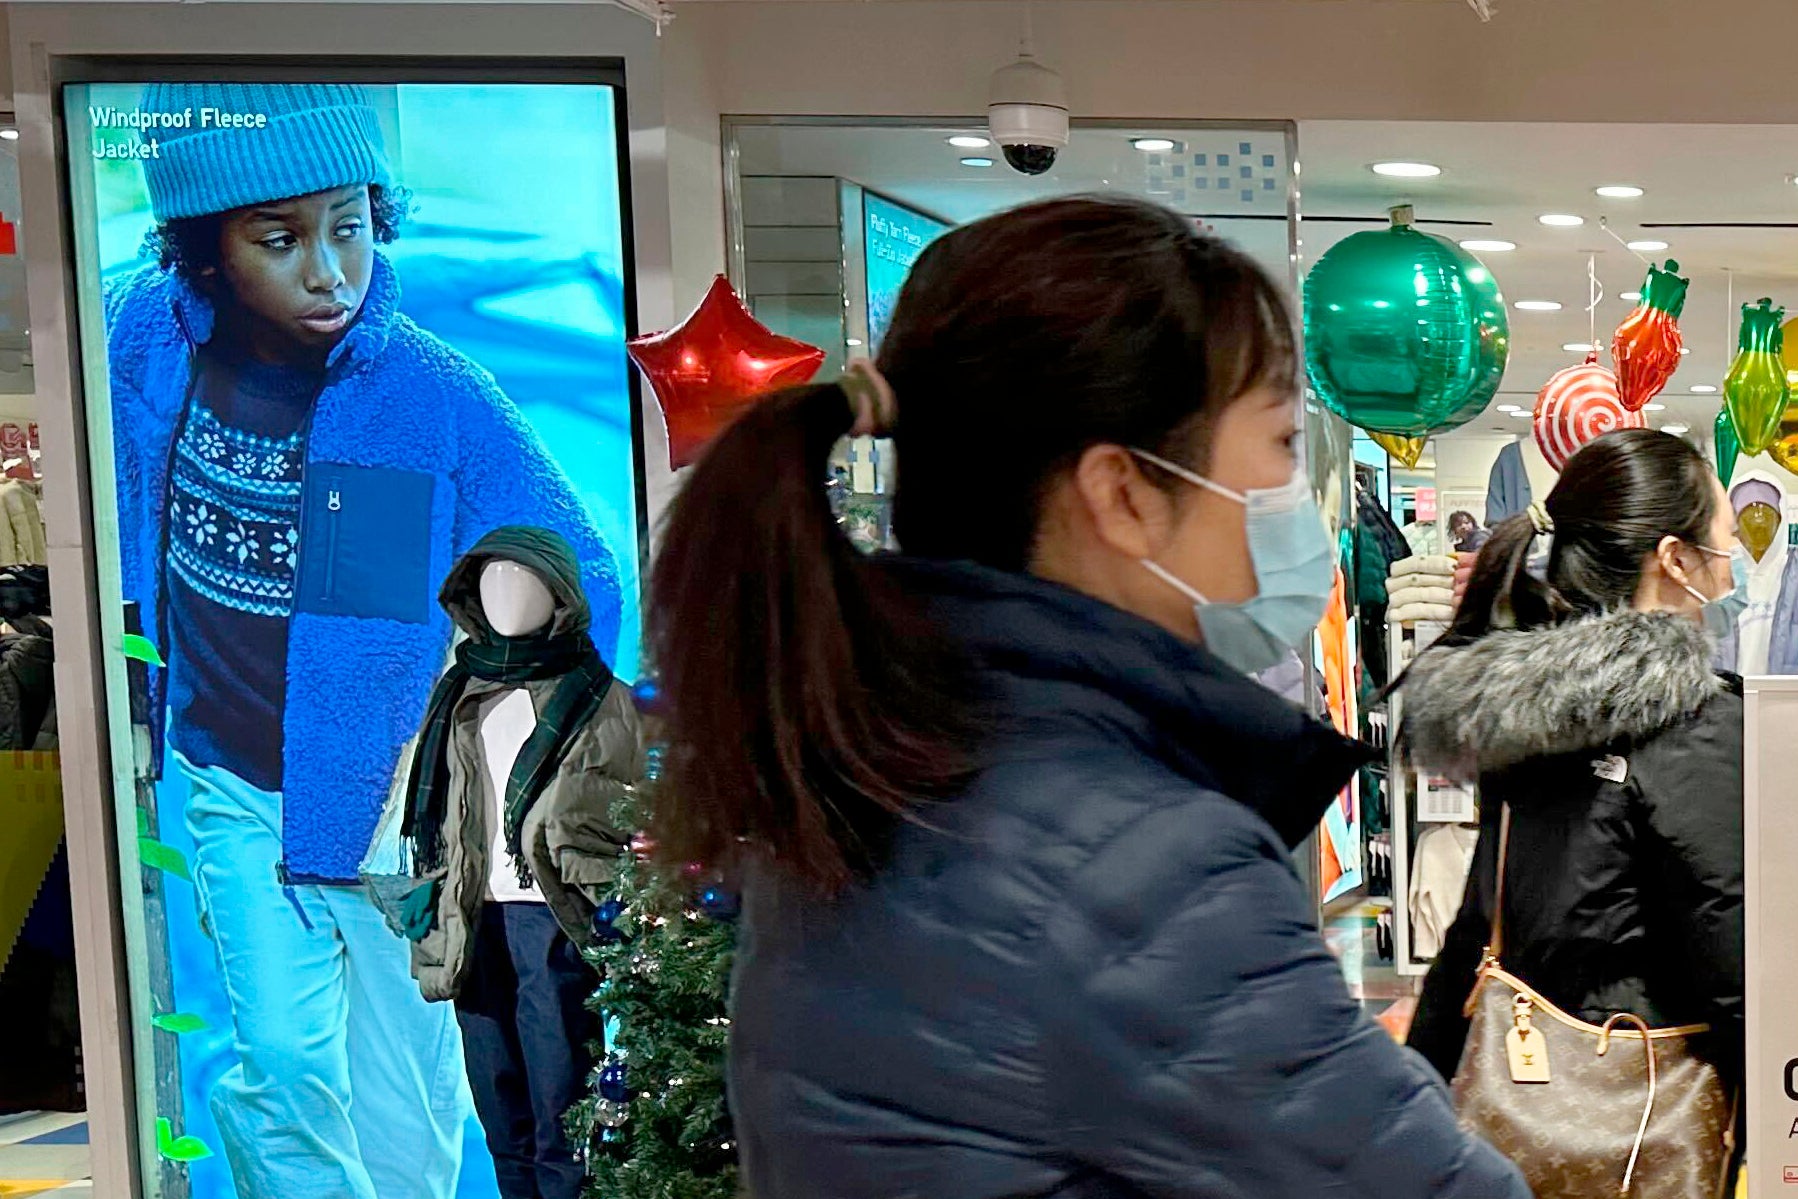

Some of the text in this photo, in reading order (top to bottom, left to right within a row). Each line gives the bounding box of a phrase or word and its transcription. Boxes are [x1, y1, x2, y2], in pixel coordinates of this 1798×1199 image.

[89, 106, 267, 132] Windproof Fleece
[92, 138, 160, 159] Jacket
